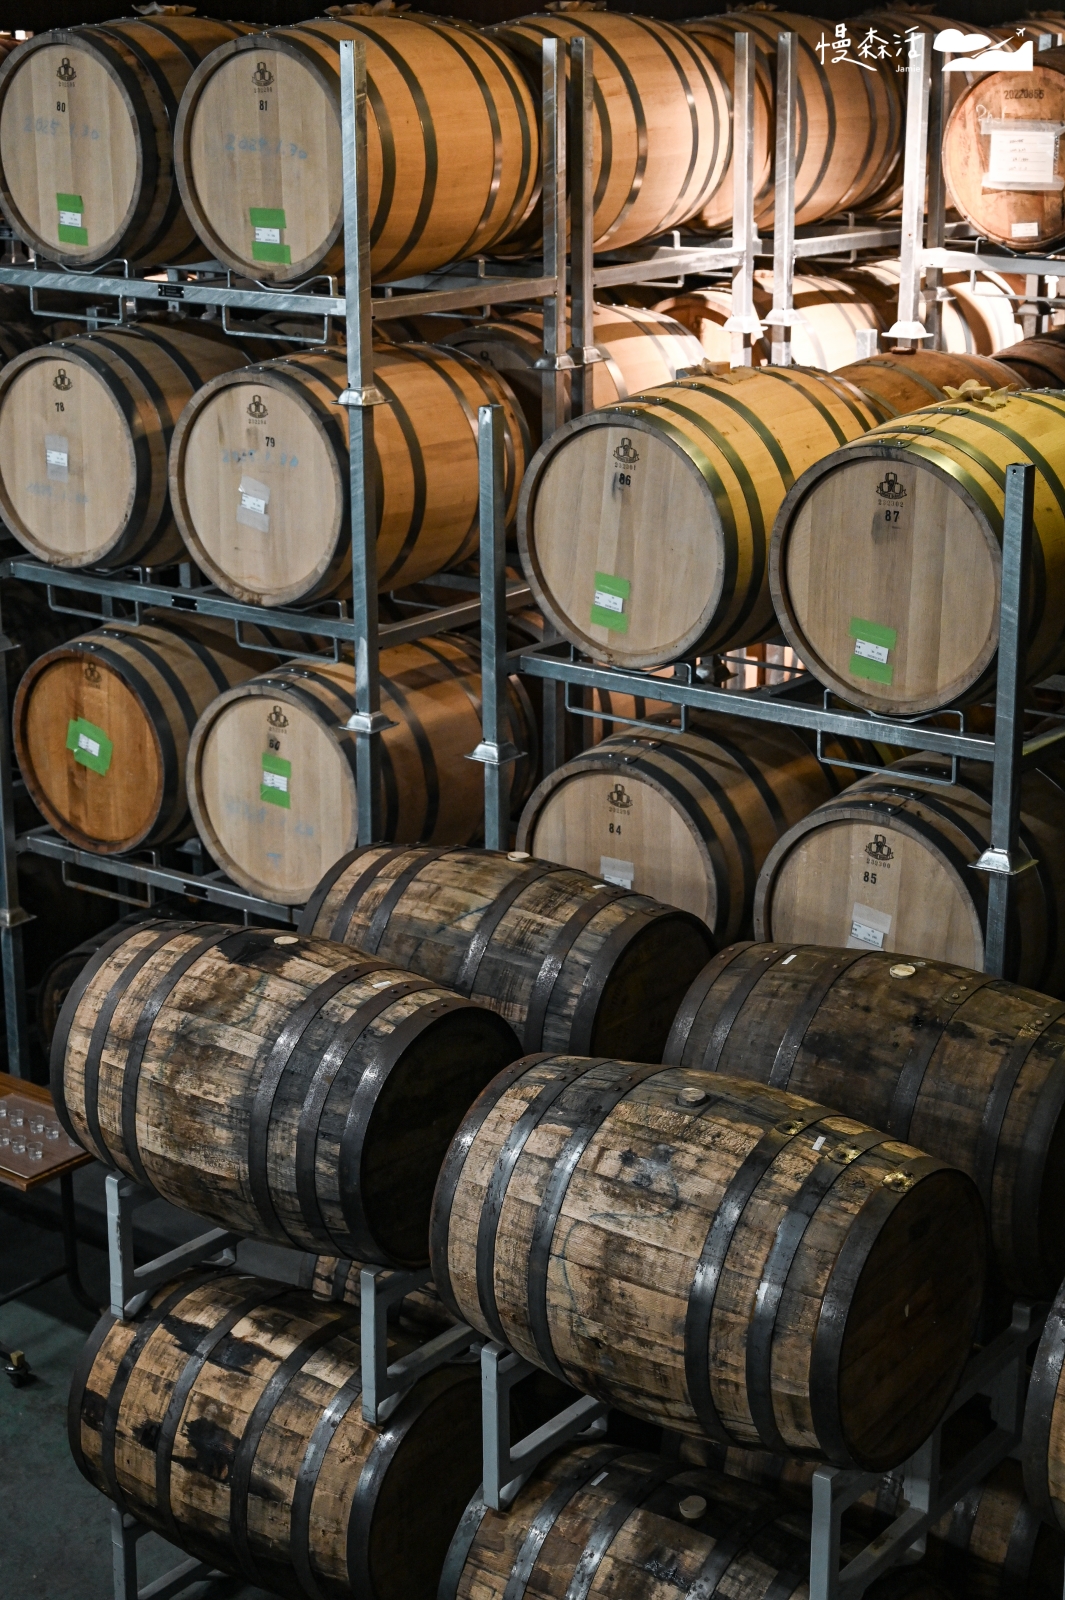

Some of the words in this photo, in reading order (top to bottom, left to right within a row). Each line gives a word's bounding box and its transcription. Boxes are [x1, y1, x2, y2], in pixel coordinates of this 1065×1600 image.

[56, 101, 66, 112] 80
[259, 100, 268, 111] 81
[55, 402, 65, 412] 78
[265, 437, 275, 448] 79
[619, 473, 631, 486] 86
[885, 510, 899, 523] 87
[608, 823, 622, 836] 84
[863, 871, 877, 885] 85
